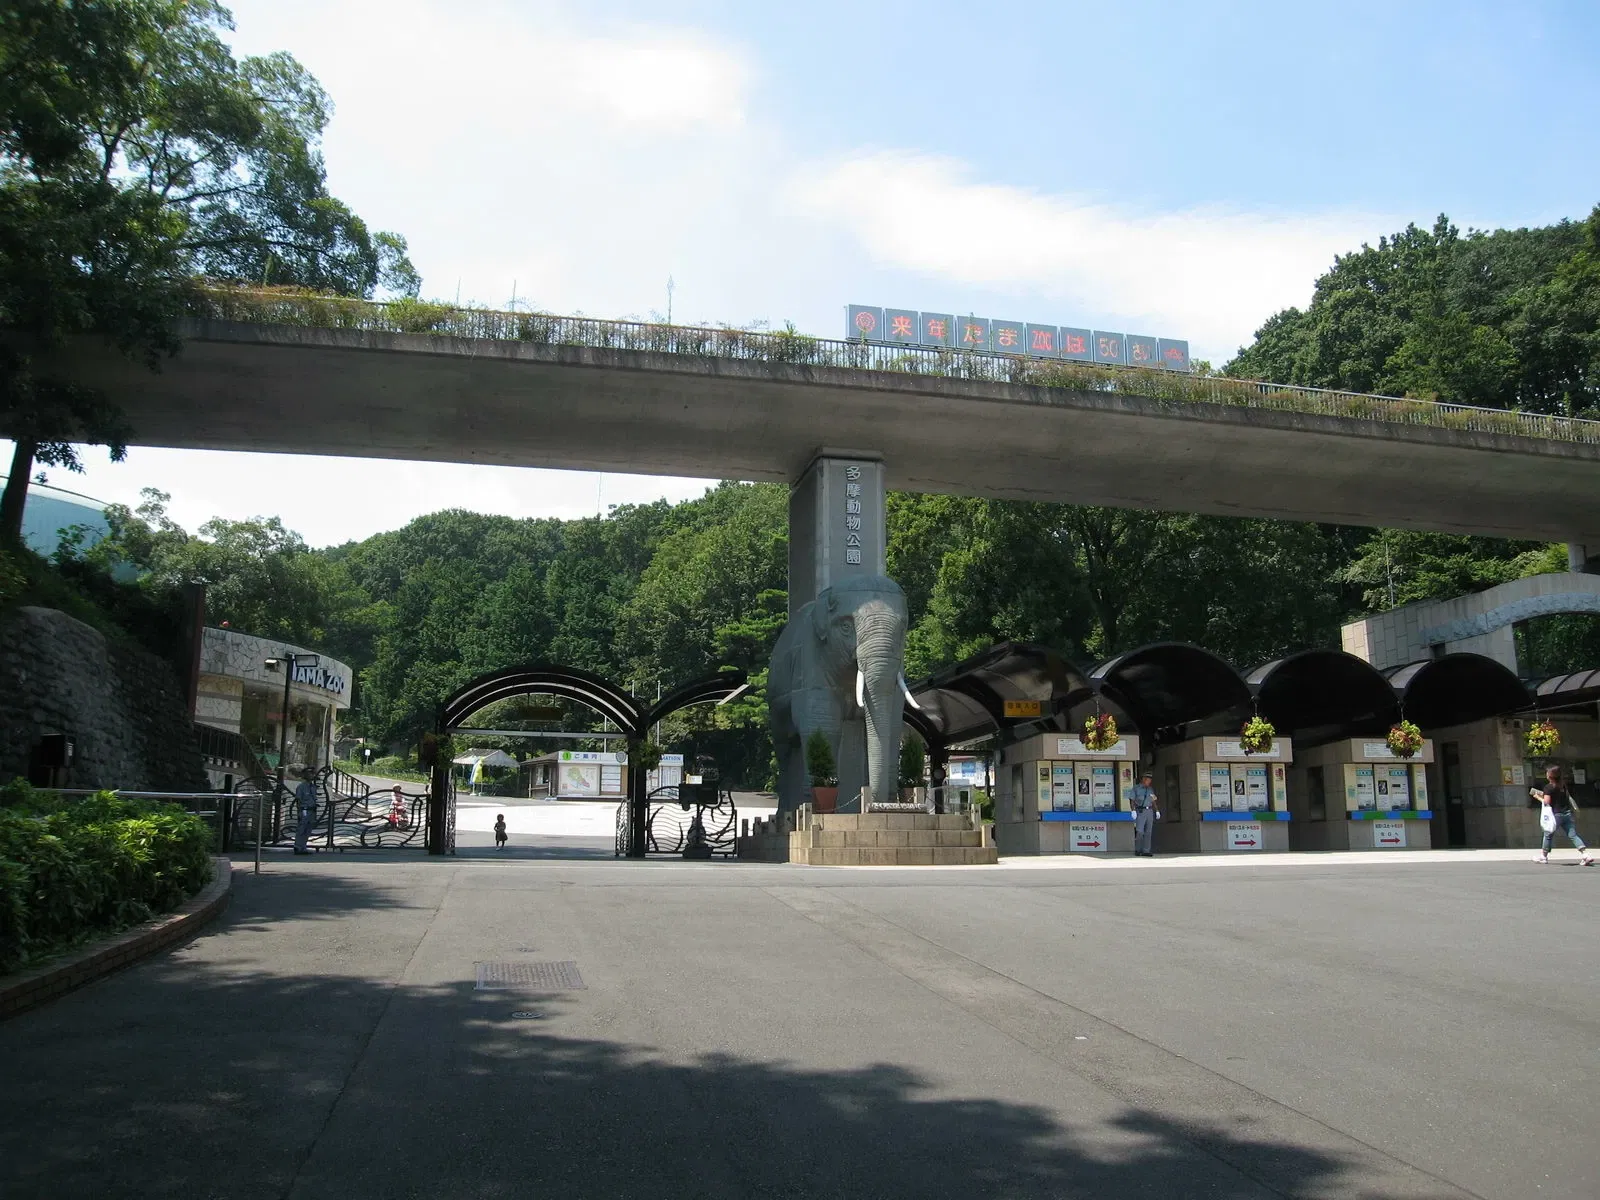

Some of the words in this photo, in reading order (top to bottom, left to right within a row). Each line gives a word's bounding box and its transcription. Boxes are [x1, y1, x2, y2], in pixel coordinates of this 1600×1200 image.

[846, 465, 861, 564] 多摩動物公園
[326, 672, 345, 694] ZOO
